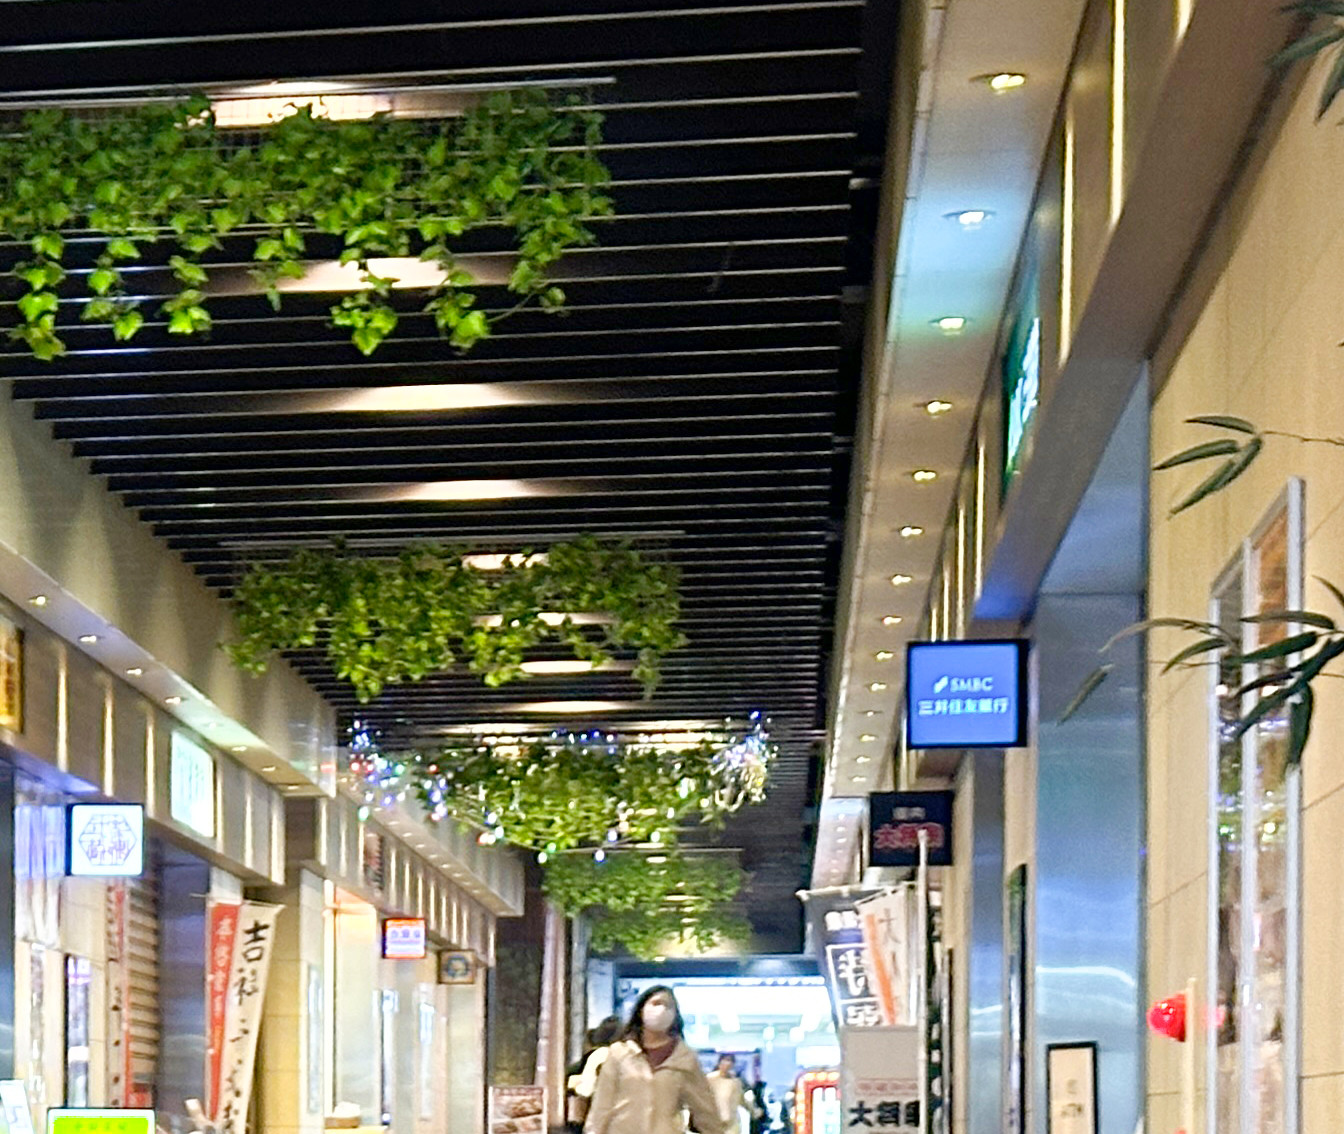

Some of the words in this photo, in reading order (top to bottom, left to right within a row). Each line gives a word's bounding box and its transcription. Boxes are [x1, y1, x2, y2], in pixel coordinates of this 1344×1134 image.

[950, 676, 994, 692] SMBC
[918, 697, 1009, 716] 三井住友銀行
